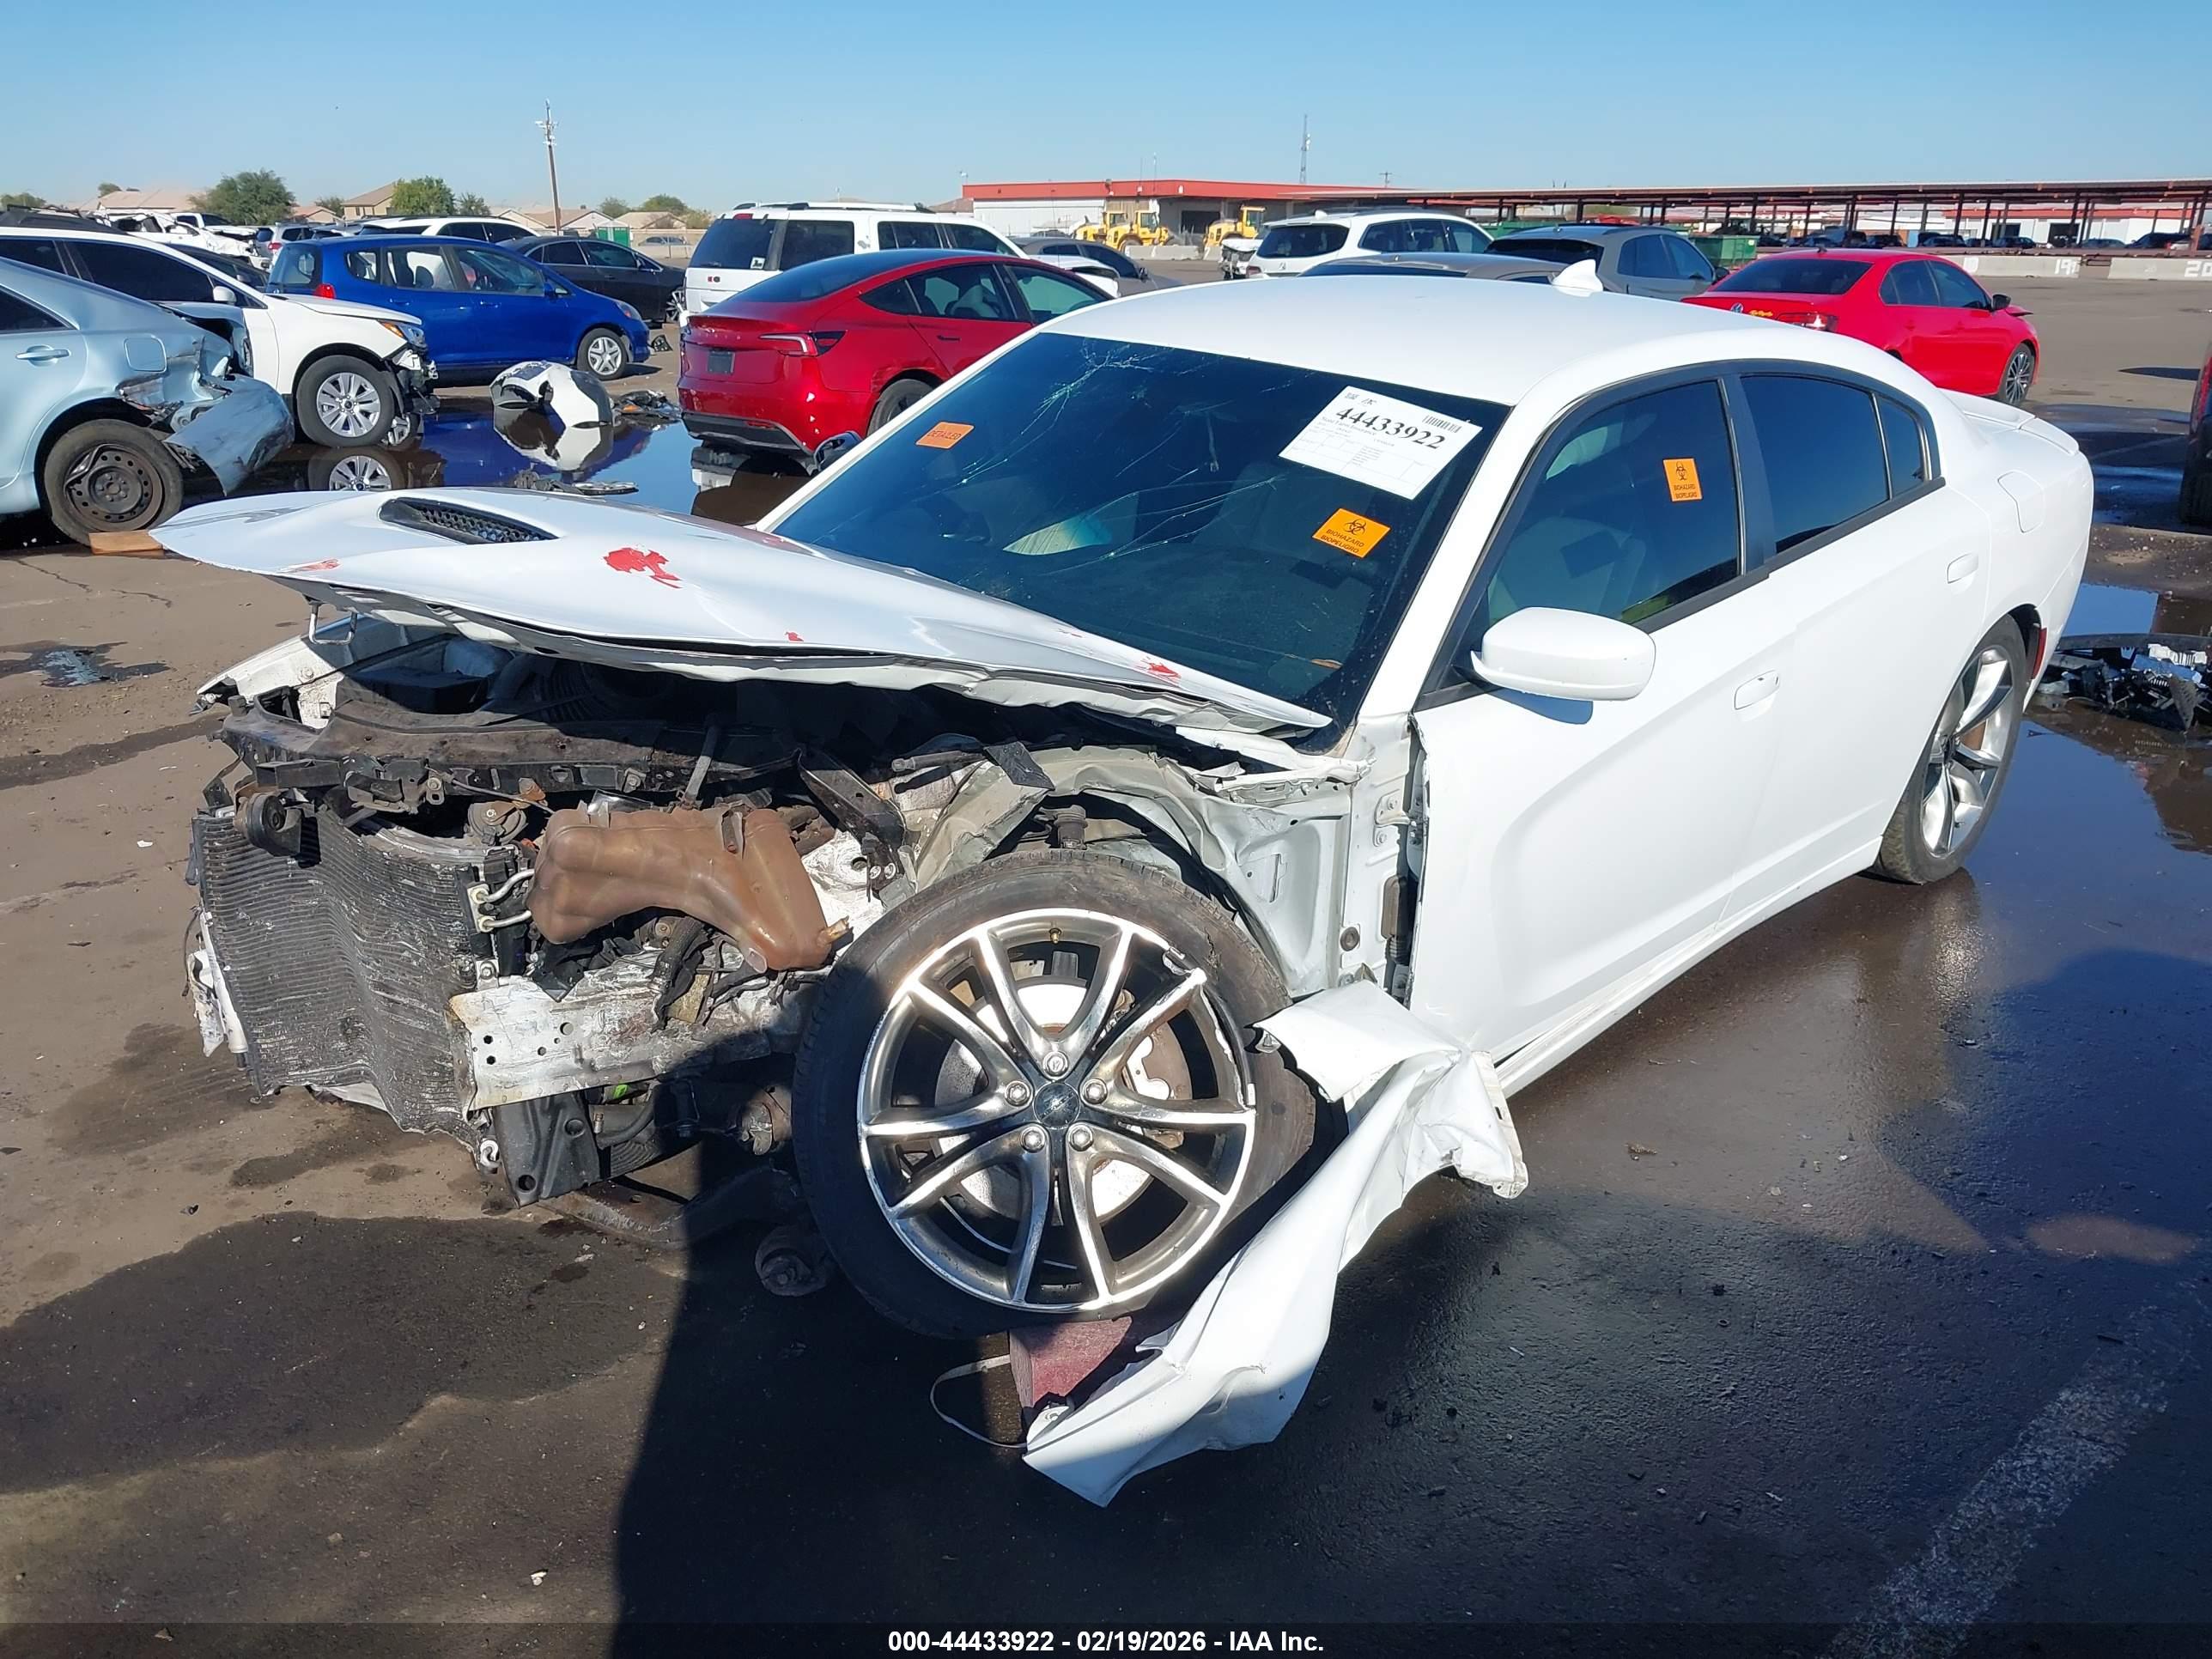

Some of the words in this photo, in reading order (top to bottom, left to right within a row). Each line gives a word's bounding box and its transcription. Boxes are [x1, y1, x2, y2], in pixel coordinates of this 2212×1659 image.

[1335, 408, 1446, 449] 44433922
[1320, 534, 1359, 554] BIOPELIGRO
[1325, 528, 1365, 548] BIOHAZARD
